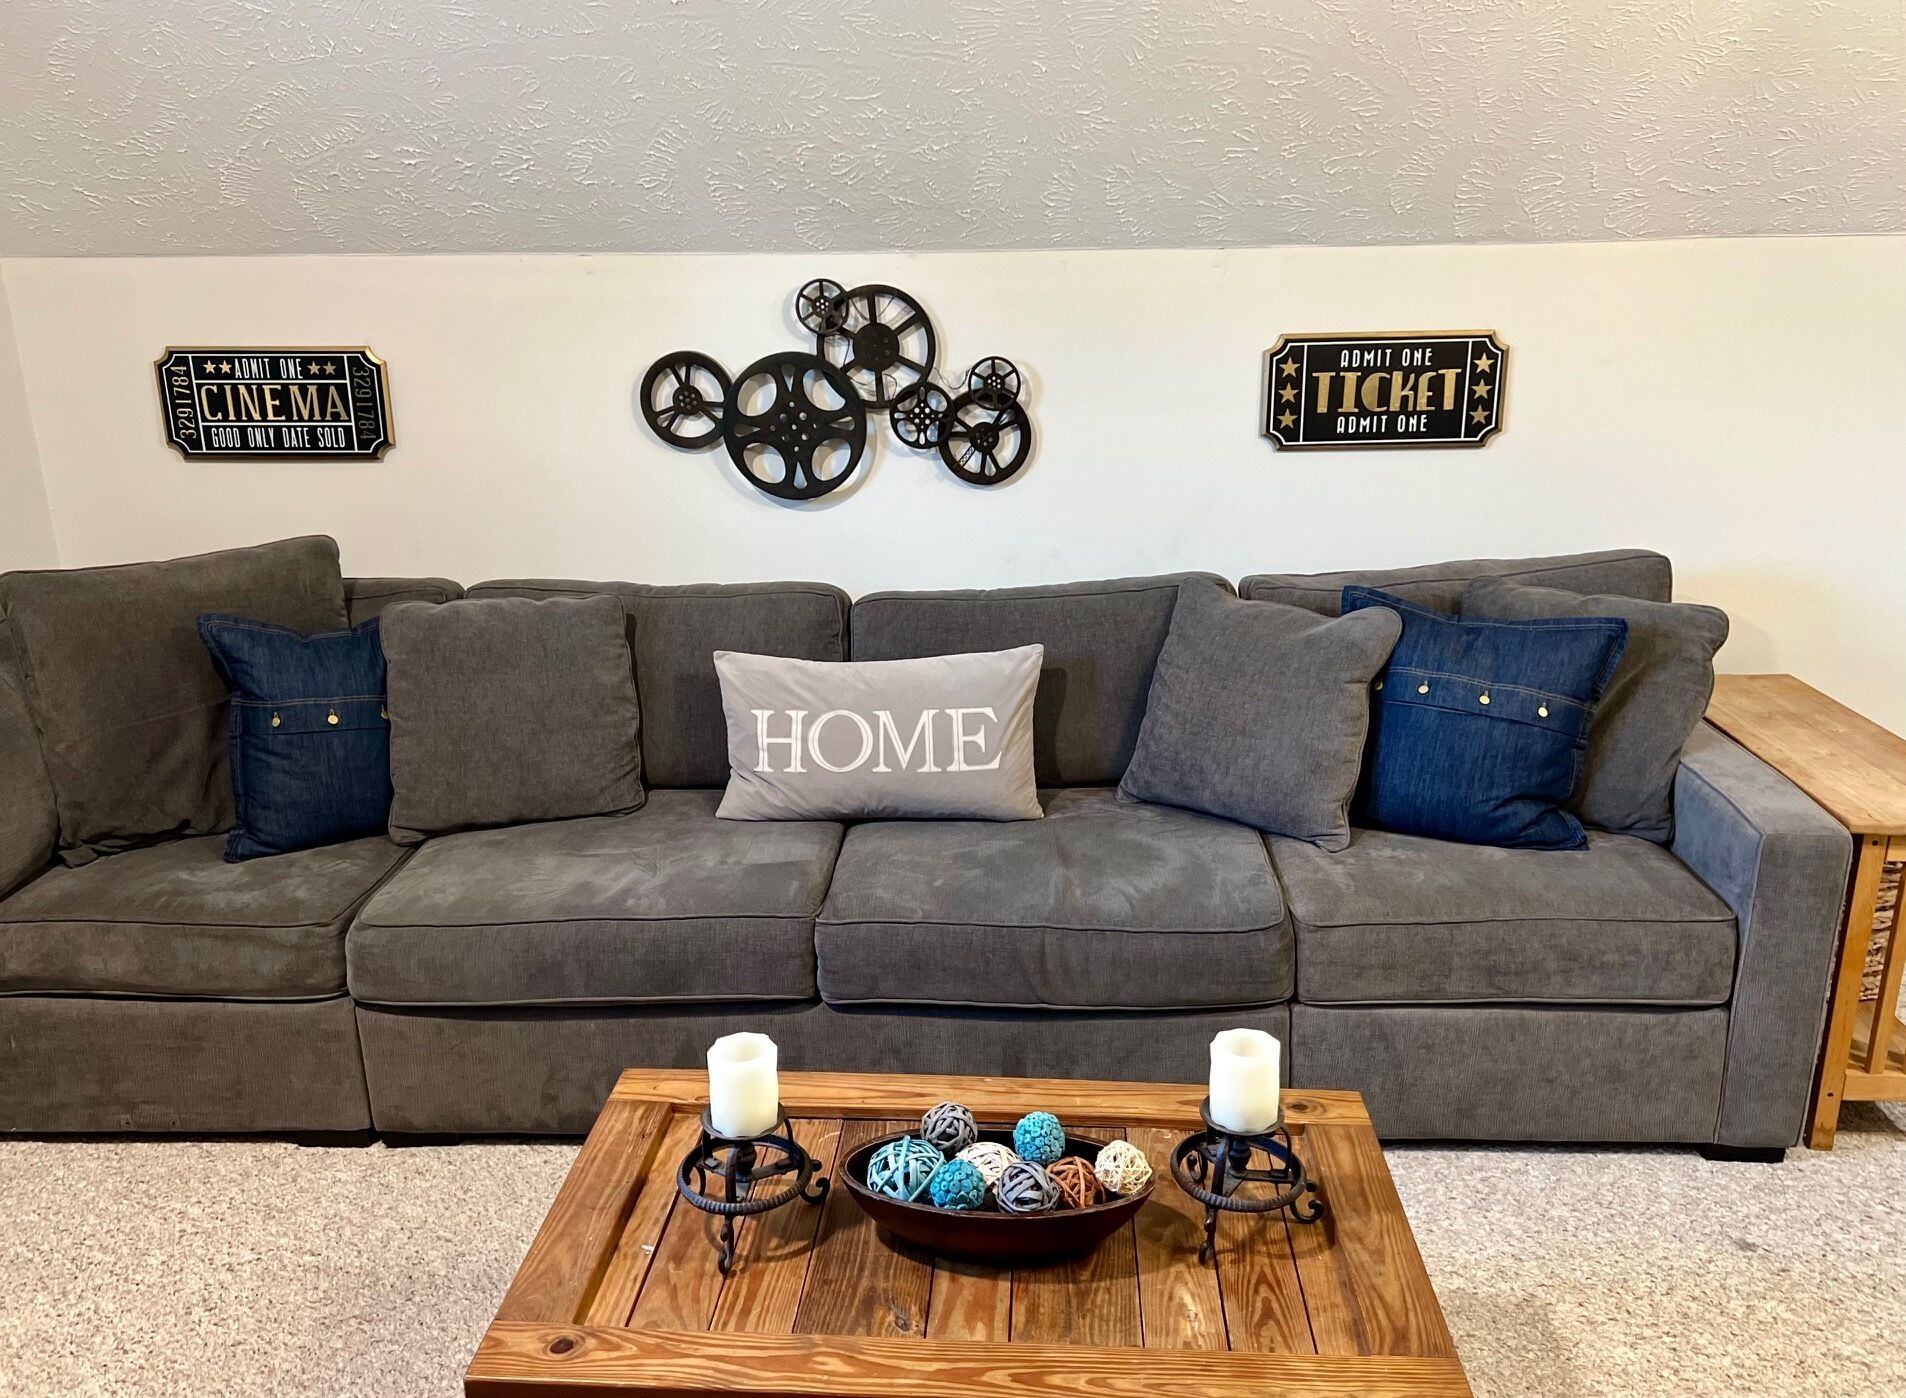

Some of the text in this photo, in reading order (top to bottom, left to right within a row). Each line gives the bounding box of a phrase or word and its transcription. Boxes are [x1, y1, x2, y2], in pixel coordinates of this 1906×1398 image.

[234, 358, 304, 379] ADMIT ONE
[1340, 348, 1433, 368] ADMIT ONE
[170, 365, 197, 439] 3291784
[200, 384, 349, 421] CINEMA
[352, 366, 376, 440] 3291784
[1312, 368, 1462, 414] TICKET
[211, 427, 346, 448] GOOD ONLY DATE SOLD
[1336, 414, 1428, 434] ADMIT ONE
[750, 706, 1002, 773] HOME
